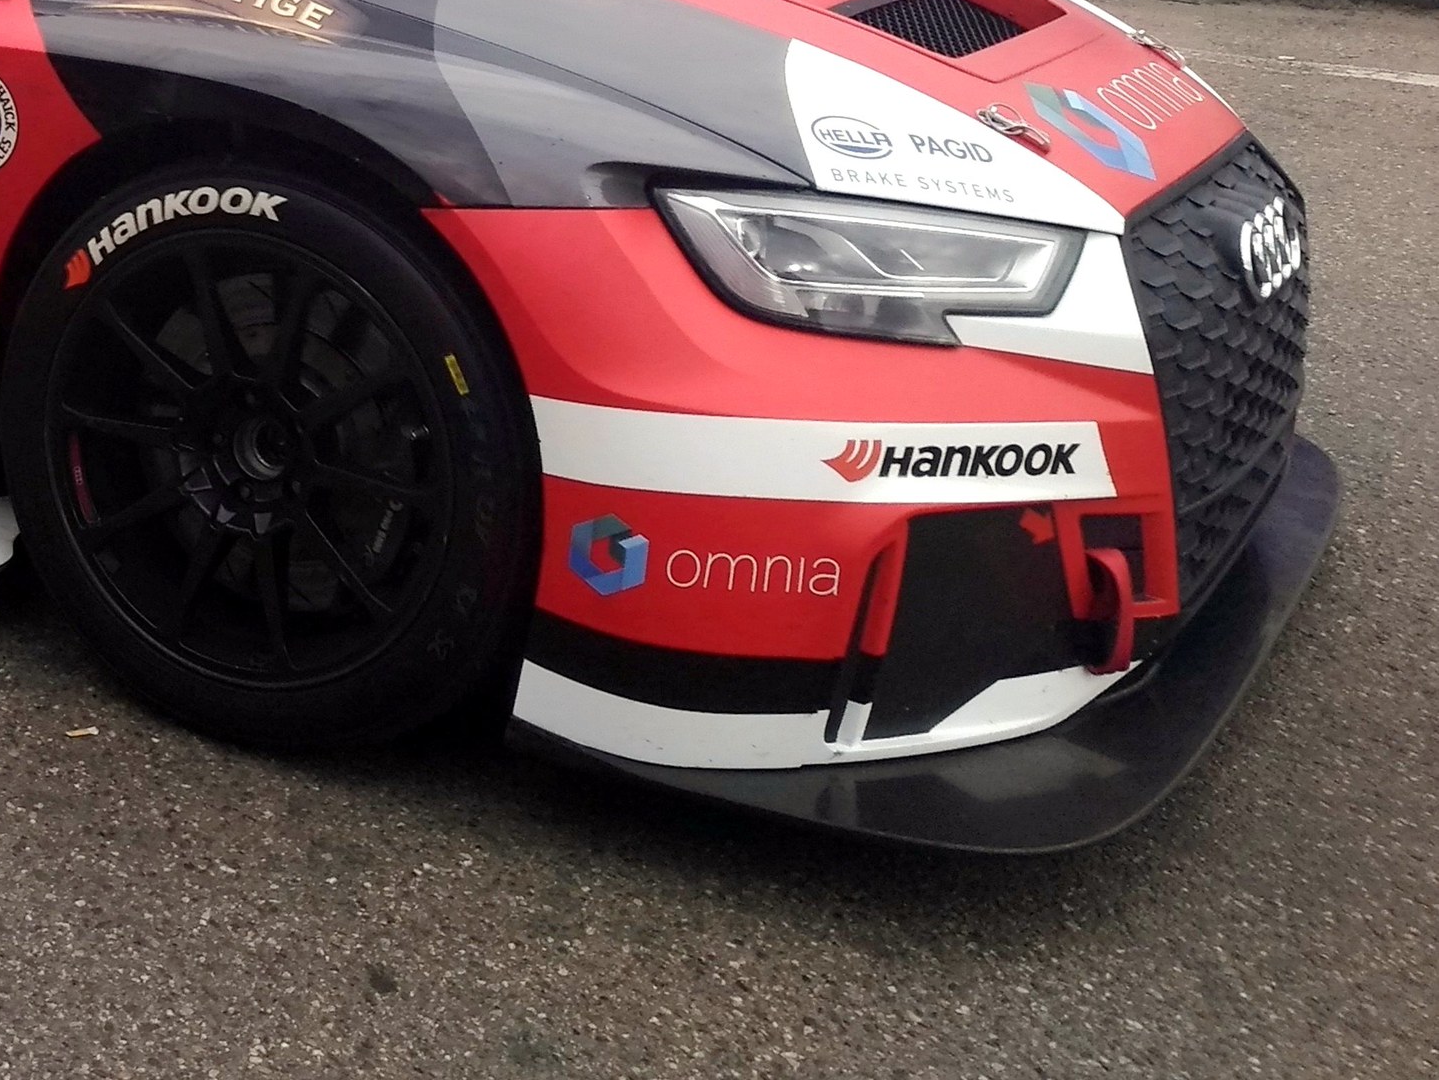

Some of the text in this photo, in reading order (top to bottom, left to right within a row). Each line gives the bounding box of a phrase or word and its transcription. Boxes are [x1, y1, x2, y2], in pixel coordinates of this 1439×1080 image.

[1096, 61, 1206, 130] omnia
[818, 128, 993, 163] HELLA PAGID
[831, 168, 1015, 203] BRAKE SYSTEMS
[665, 545, 842, 597] omnia
